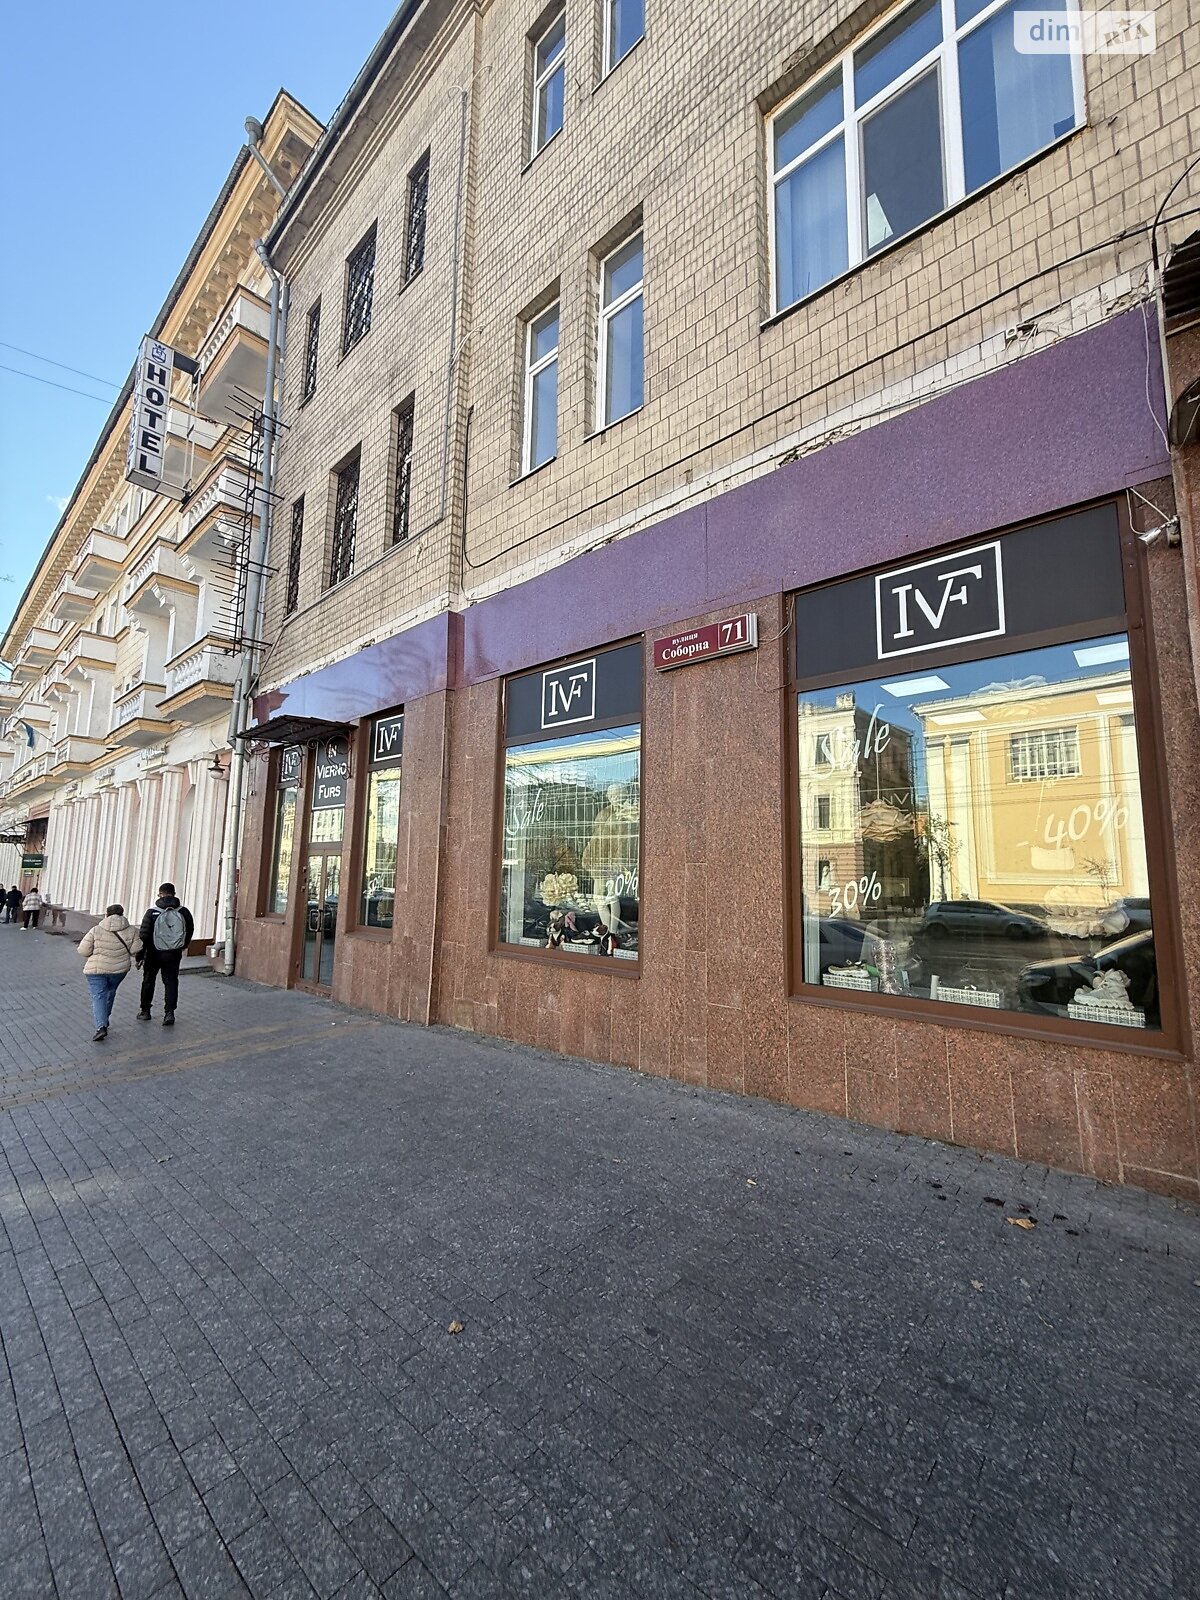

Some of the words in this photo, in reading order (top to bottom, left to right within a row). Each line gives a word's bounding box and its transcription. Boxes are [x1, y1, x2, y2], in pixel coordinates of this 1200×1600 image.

[138, 361, 167, 476] HOTEL
[892, 564, 983, 640] IVF
[671, 632, 698, 646] вулиця
[721, 620, 744, 643] 71
[661, 640, 710, 660] Соборна
[548, 672, 588, 717] IVF
[378, 723, 402, 753] IVF
[316, 762, 347, 780] VIERNO
[318, 784, 341, 800] FURS
[828, 870, 882, 918] 30%
